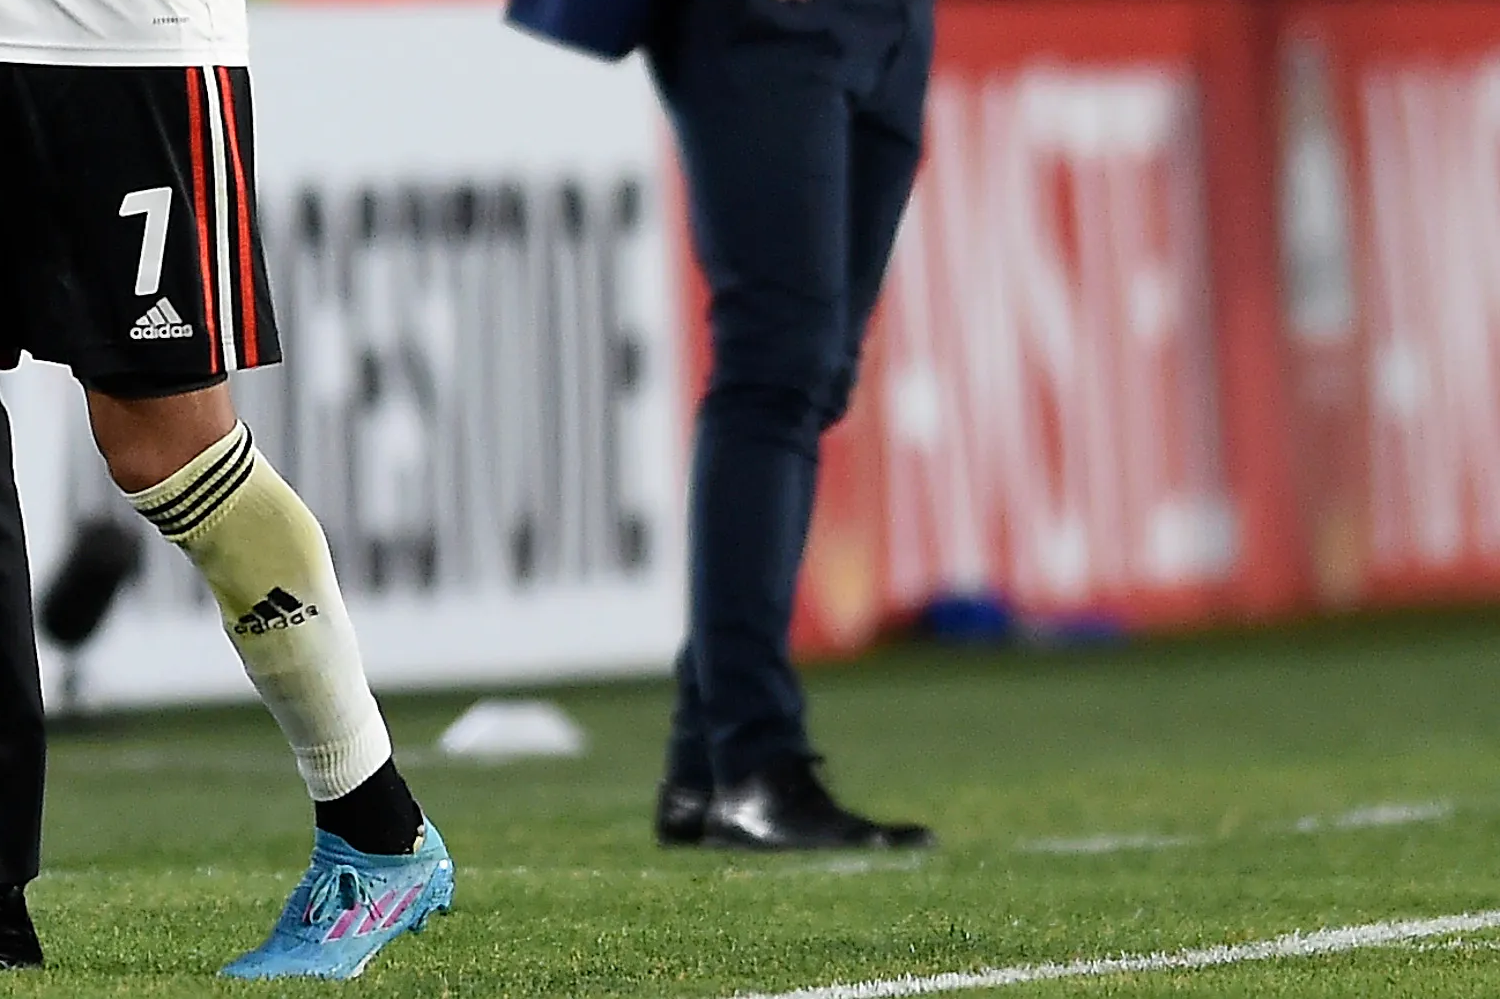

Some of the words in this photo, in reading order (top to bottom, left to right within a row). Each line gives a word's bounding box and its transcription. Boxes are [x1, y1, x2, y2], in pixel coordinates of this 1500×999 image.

[118, 186, 173, 296] 7
[129, 323, 194, 340] adidas
[234, 604, 319, 635] adidas
